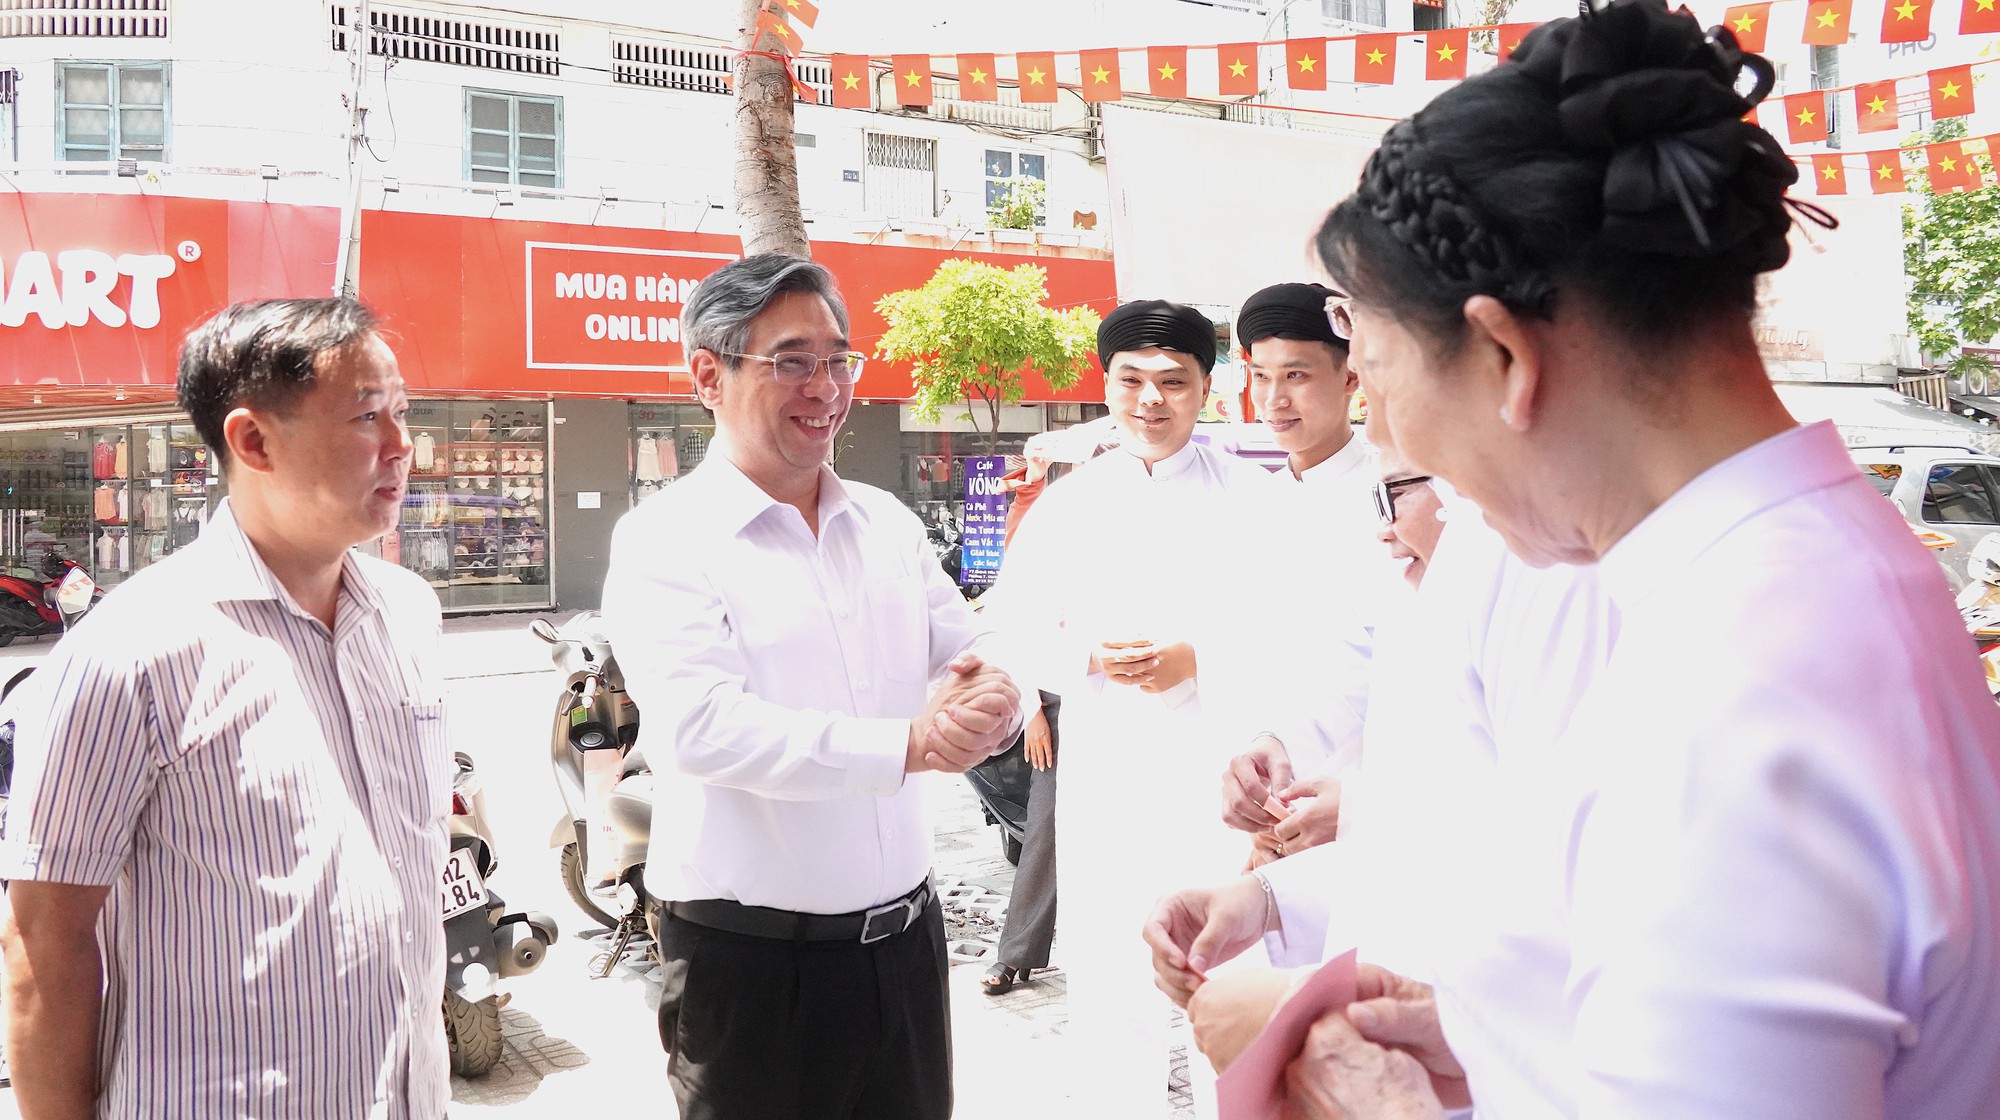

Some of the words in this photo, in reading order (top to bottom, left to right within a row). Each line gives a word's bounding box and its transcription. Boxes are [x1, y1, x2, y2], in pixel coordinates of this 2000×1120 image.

[0, 250, 176, 330] ART
[555, 272, 627, 301] MUA
[635, 272, 700, 303] HÀN
[585, 314, 684, 343] ONLIN
[976, 461, 993, 470] Café
